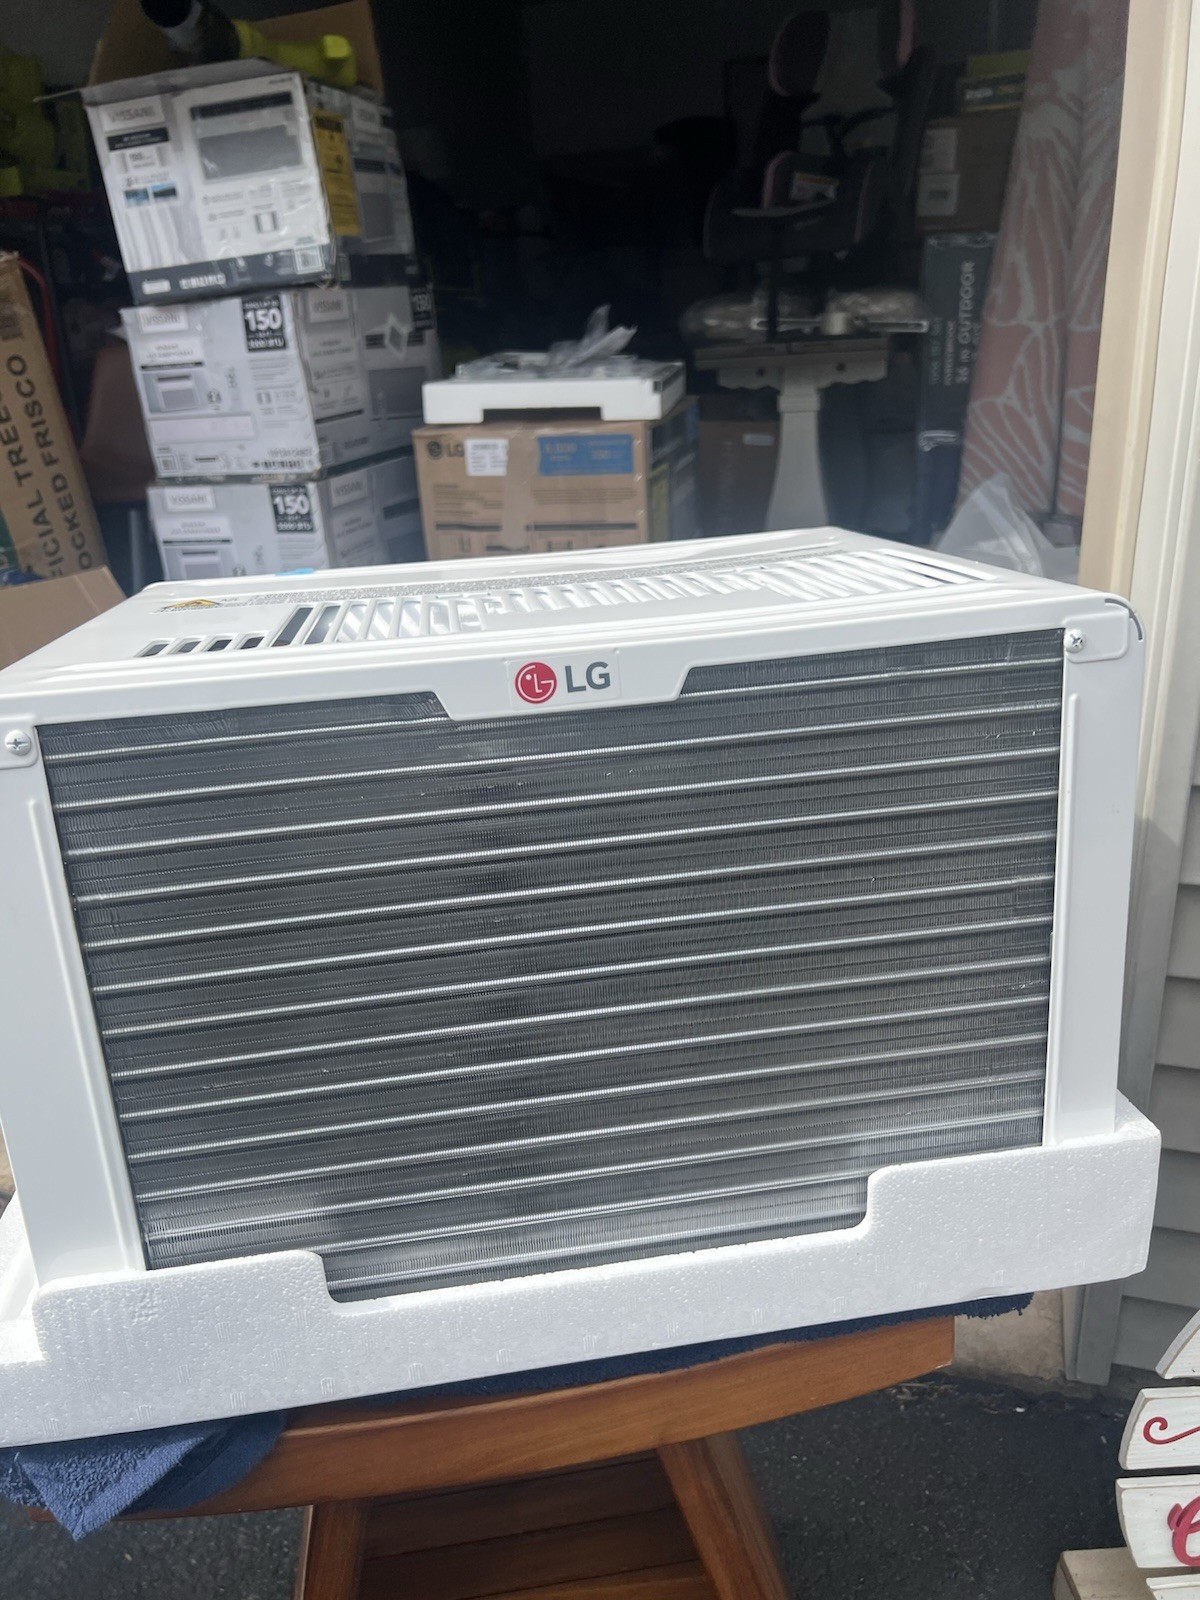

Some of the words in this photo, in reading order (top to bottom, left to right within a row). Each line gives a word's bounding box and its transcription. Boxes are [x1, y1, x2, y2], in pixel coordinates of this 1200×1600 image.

[244, 307, 283, 332] 150
[957, 260, 976, 345] OUTDOOR
[6, 354, 60, 468] FRISCO
[50, 471, 93, 570] OCKED
[273, 494, 310, 515] 150
[564, 661, 611, 693] LG
